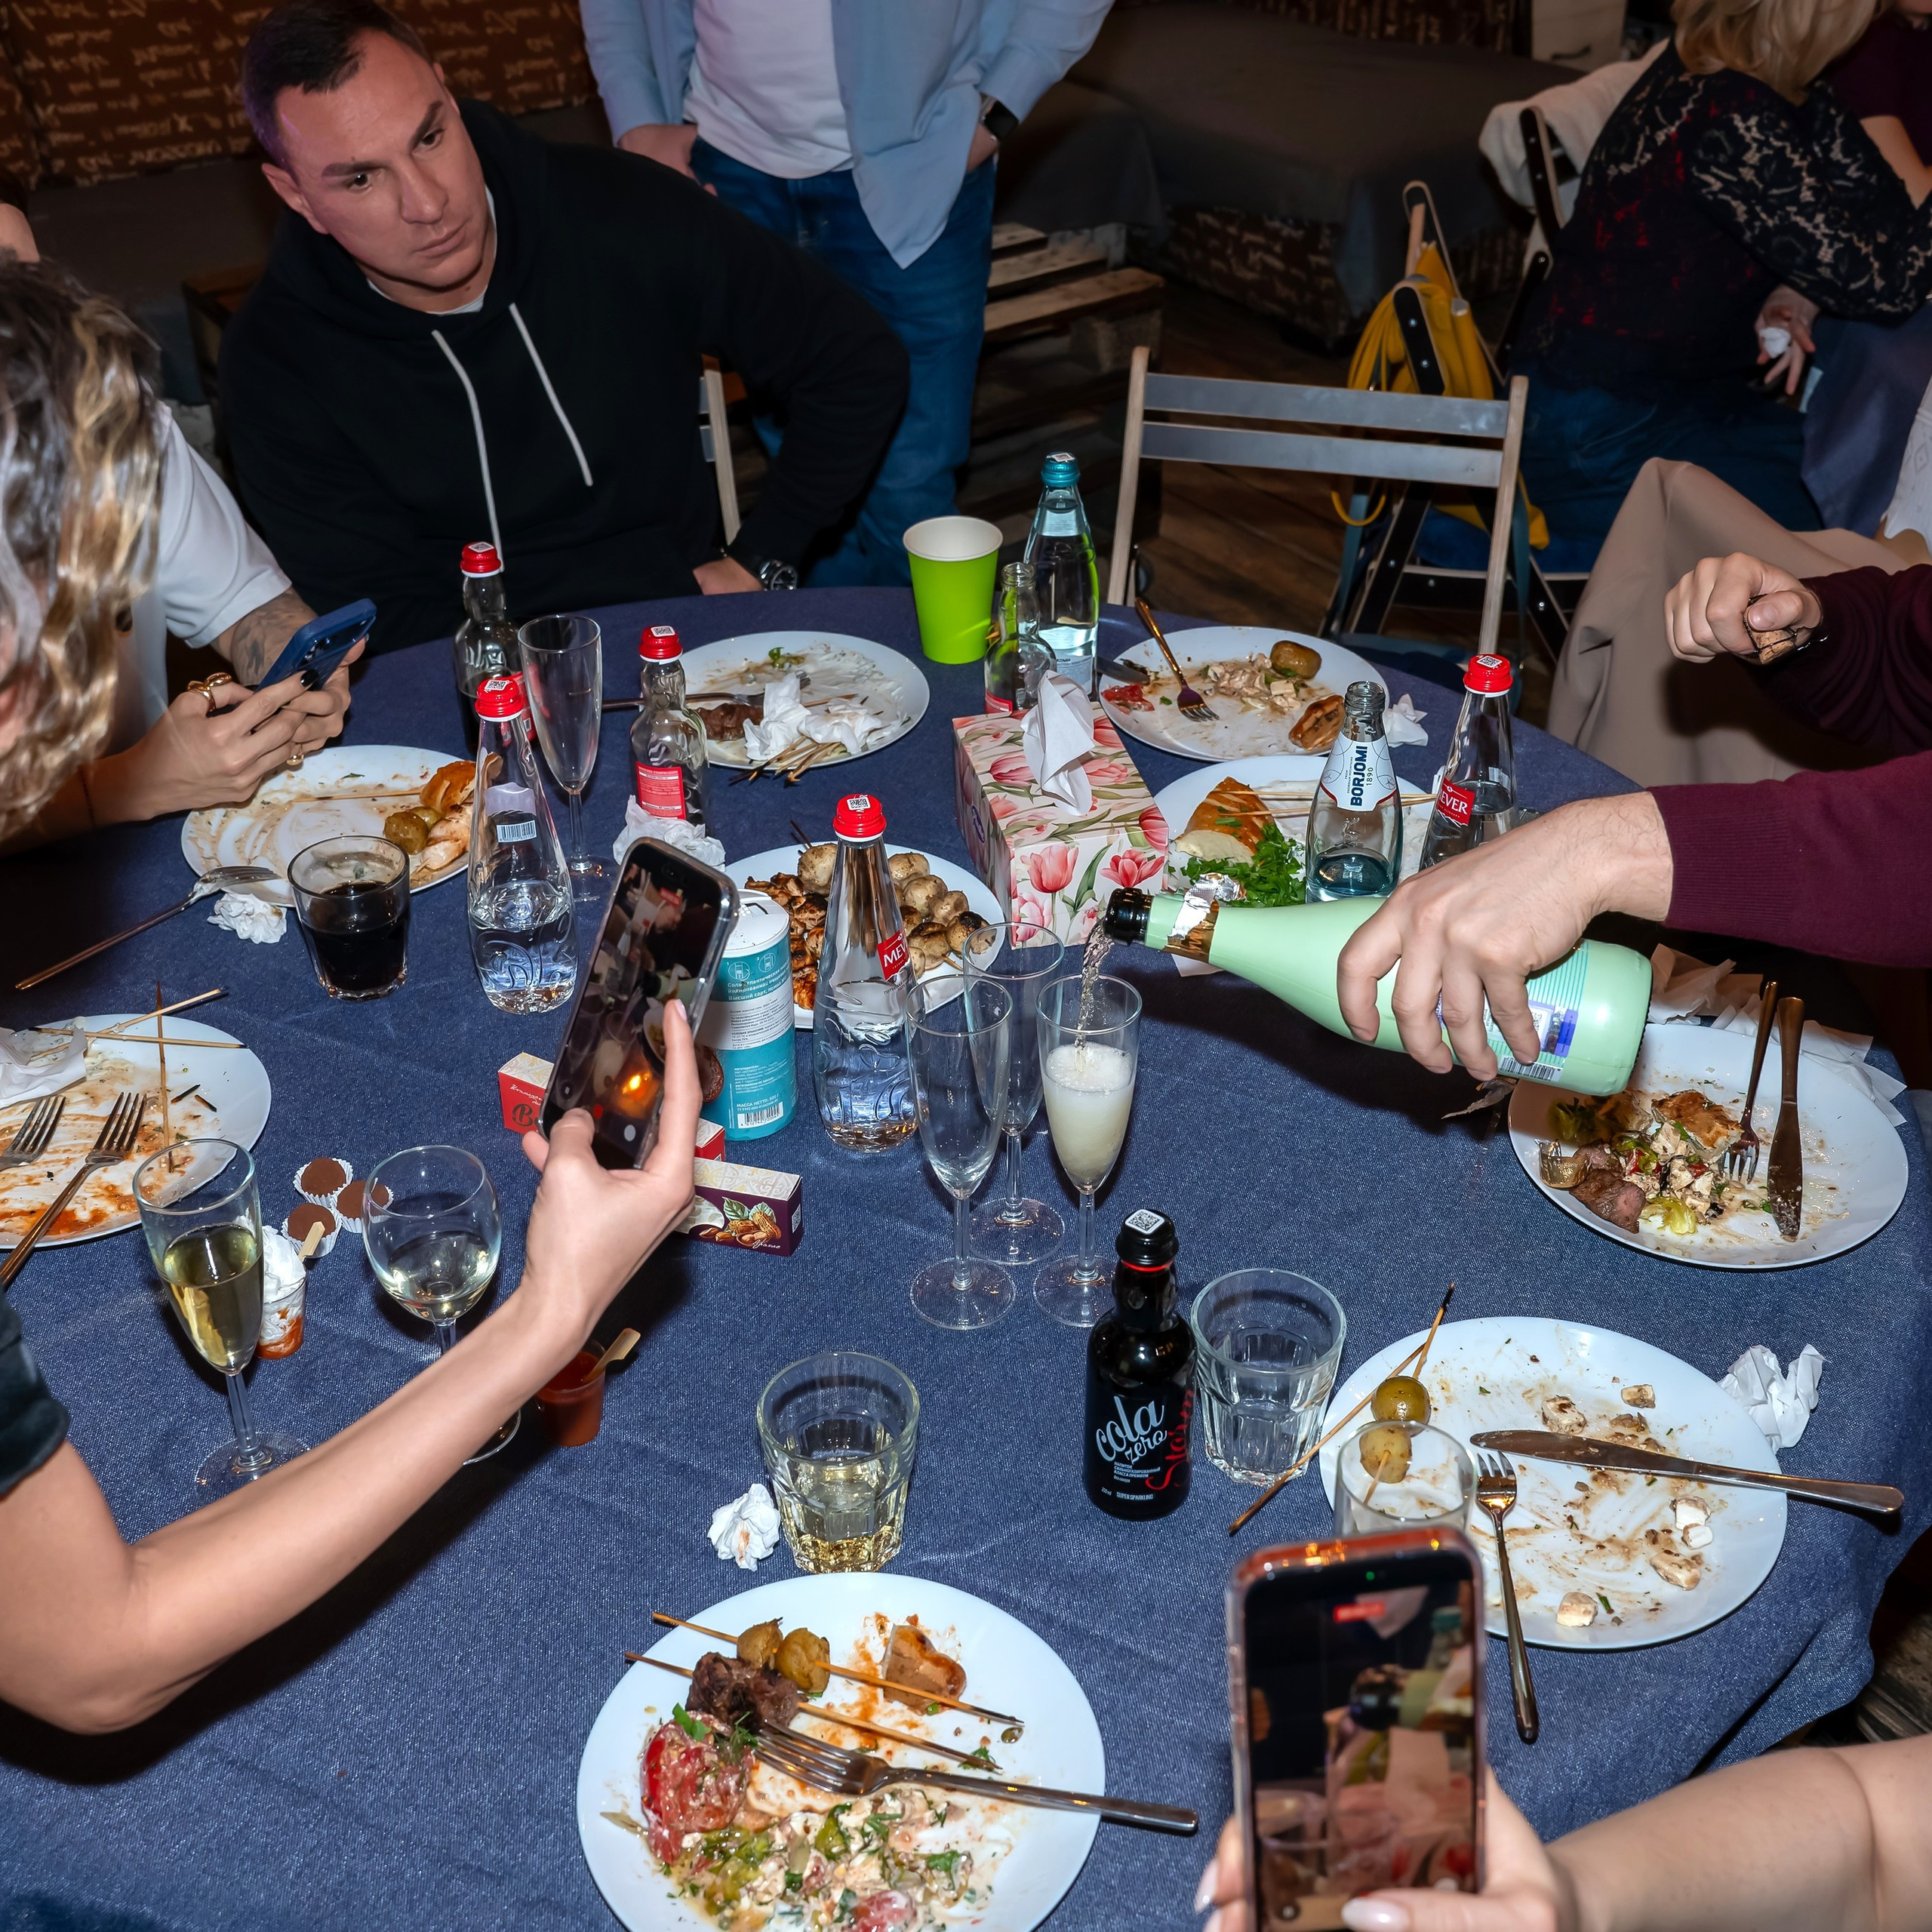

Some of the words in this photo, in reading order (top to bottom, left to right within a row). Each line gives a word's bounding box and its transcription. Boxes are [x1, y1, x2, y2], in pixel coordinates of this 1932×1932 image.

[1350, 746, 1368, 806] BORJOMI
[1440, 791, 1468, 814] EVER
[884, 943, 906, 968] MEV
[1096, 1395, 1164, 1462] cola
[1124, 1430, 1168, 1465] zero
[1116, 1491, 1130, 1500] SUPER
